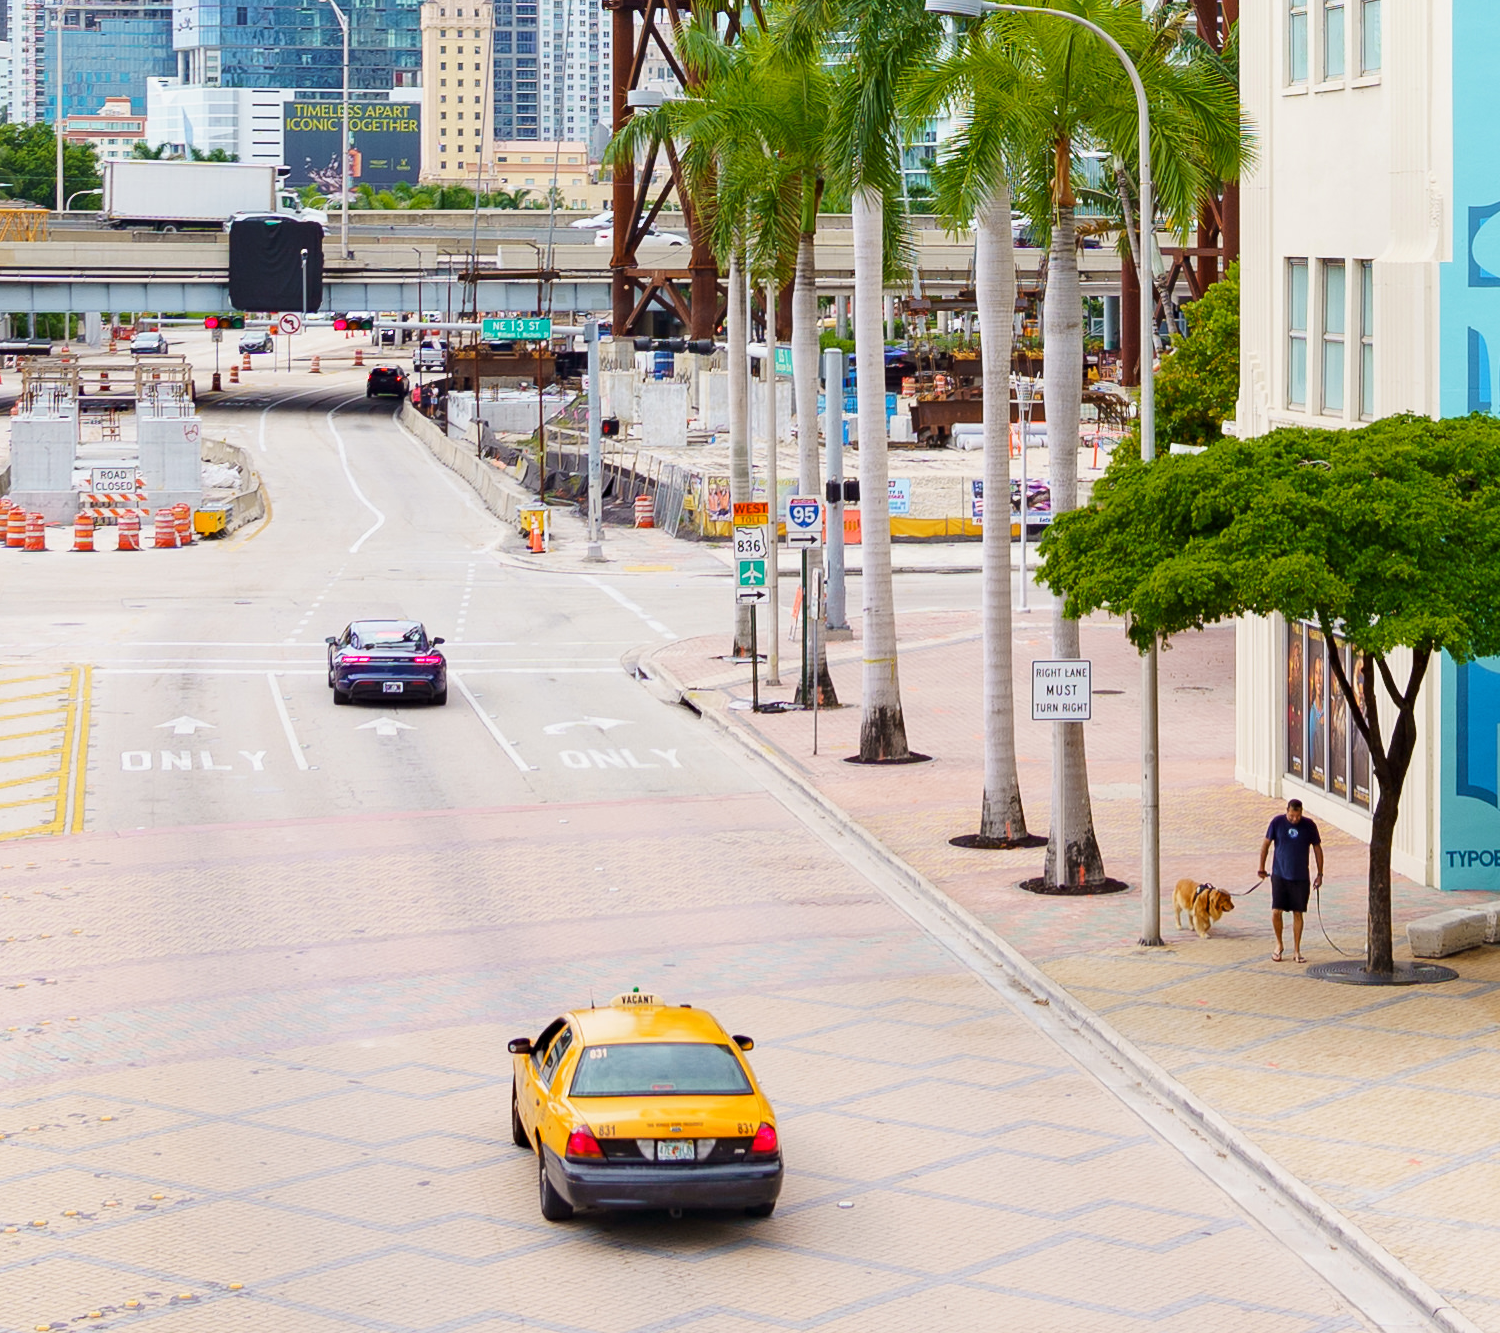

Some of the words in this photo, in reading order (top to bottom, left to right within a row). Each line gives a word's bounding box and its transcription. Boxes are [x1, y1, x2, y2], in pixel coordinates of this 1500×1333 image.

[294, 104, 362, 118] TIMELESS
[366, 105, 411, 118] APART
[286, 118, 339, 131] ICONIC
[492, 321, 506, 331] NE
[511, 319, 524, 332] 13
[528, 321, 540, 331] ST
[100, 470, 127, 480] ROAD
[95, 481, 133, 491] CLOSED
[734, 503, 768, 514] WEST
[741, 516, 763, 524] TOLL
[792, 506, 817, 524] 95
[737, 539, 761, 552] 836
[1036, 668, 1062, 678] RIGHT
[1064, 668, 1087, 678] LANE
[1046, 684, 1077, 697] MUST
[1035, 702, 1059, 713] TURN
[1062, 702, 1088, 713] RIGHT
[120, 749, 270, 772] ONLY
[558, 747, 684, 770] ONLY
[621, 995, 654, 1005] VACANT
[599, 1125, 616, 1137] 831
[737, 1123, 754, 1134] 831
